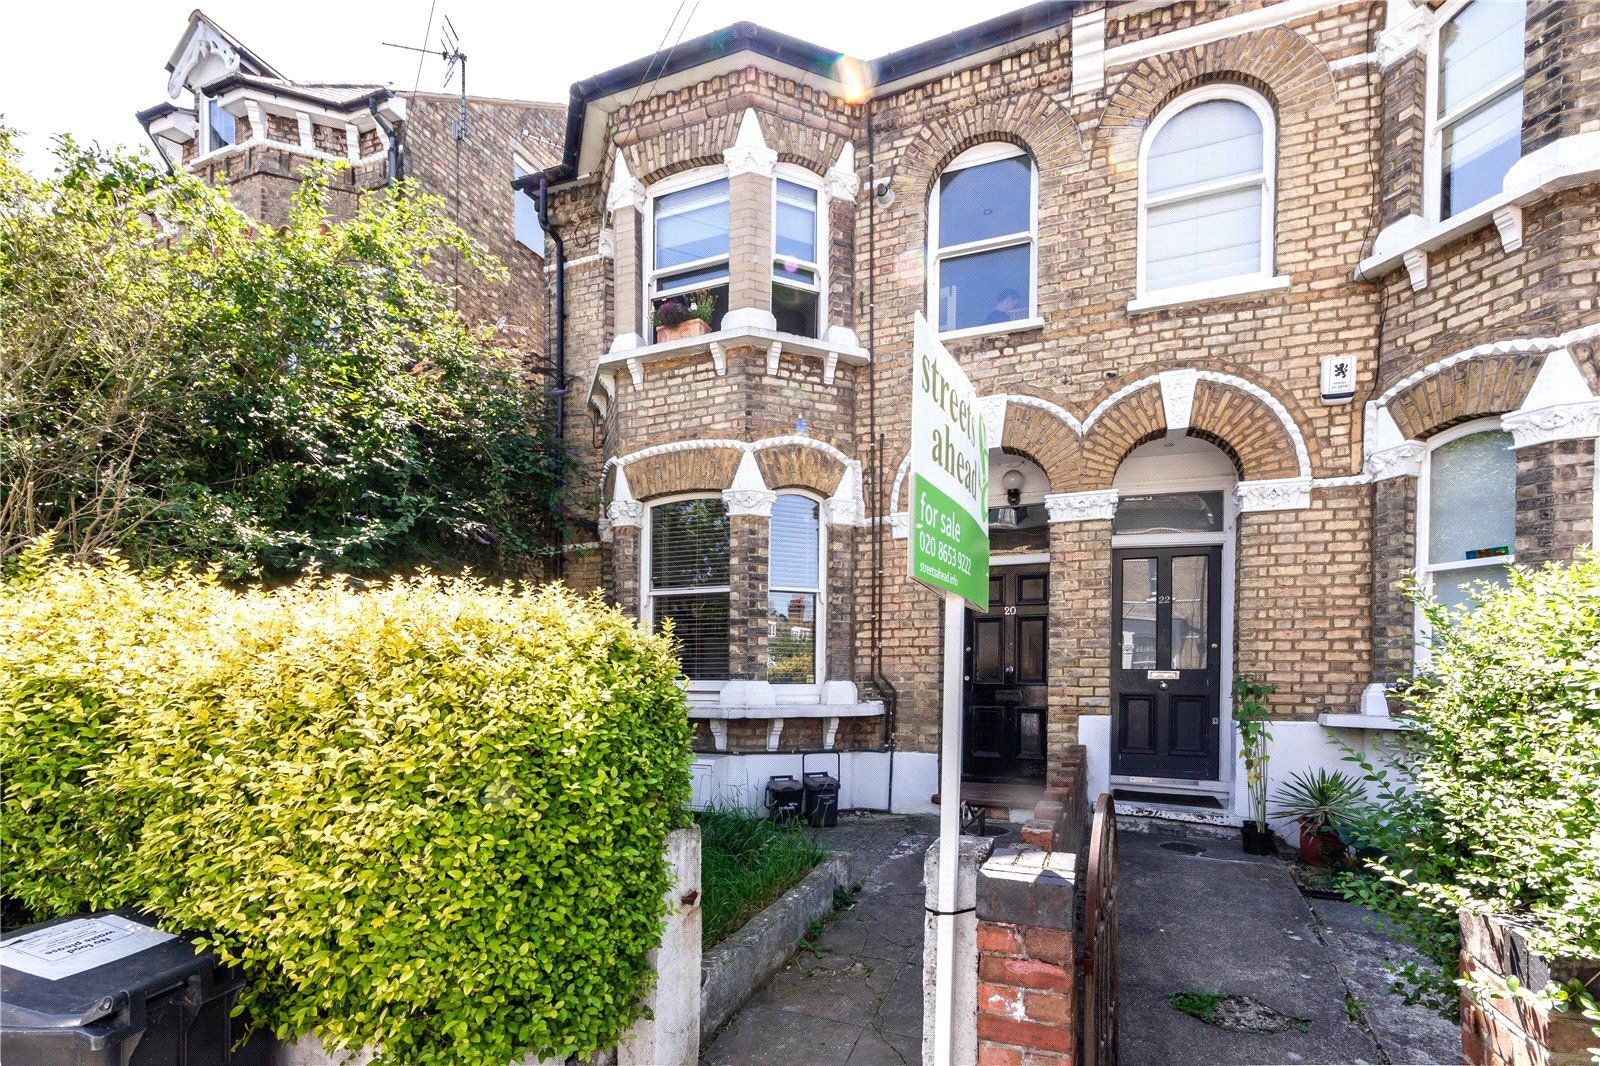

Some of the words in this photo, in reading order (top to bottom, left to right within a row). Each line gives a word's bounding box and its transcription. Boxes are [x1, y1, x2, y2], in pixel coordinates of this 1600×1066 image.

[931, 423, 977, 501] ahead
[920, 491, 938, 529] for
[940, 512, 961, 543] sale
[919, 530, 936, 557] 020
[938, 540, 957, 568] 8653
[957, 553, 972, 576] 9222
[1158, 596, 1170, 604] 22
[1004, 606, 1016, 615] 20
[84, 930, 115, 942] waste
[94, 937, 111, 945] No
[45, 941, 82, 954] please
[67, 943, 94, 954] food
